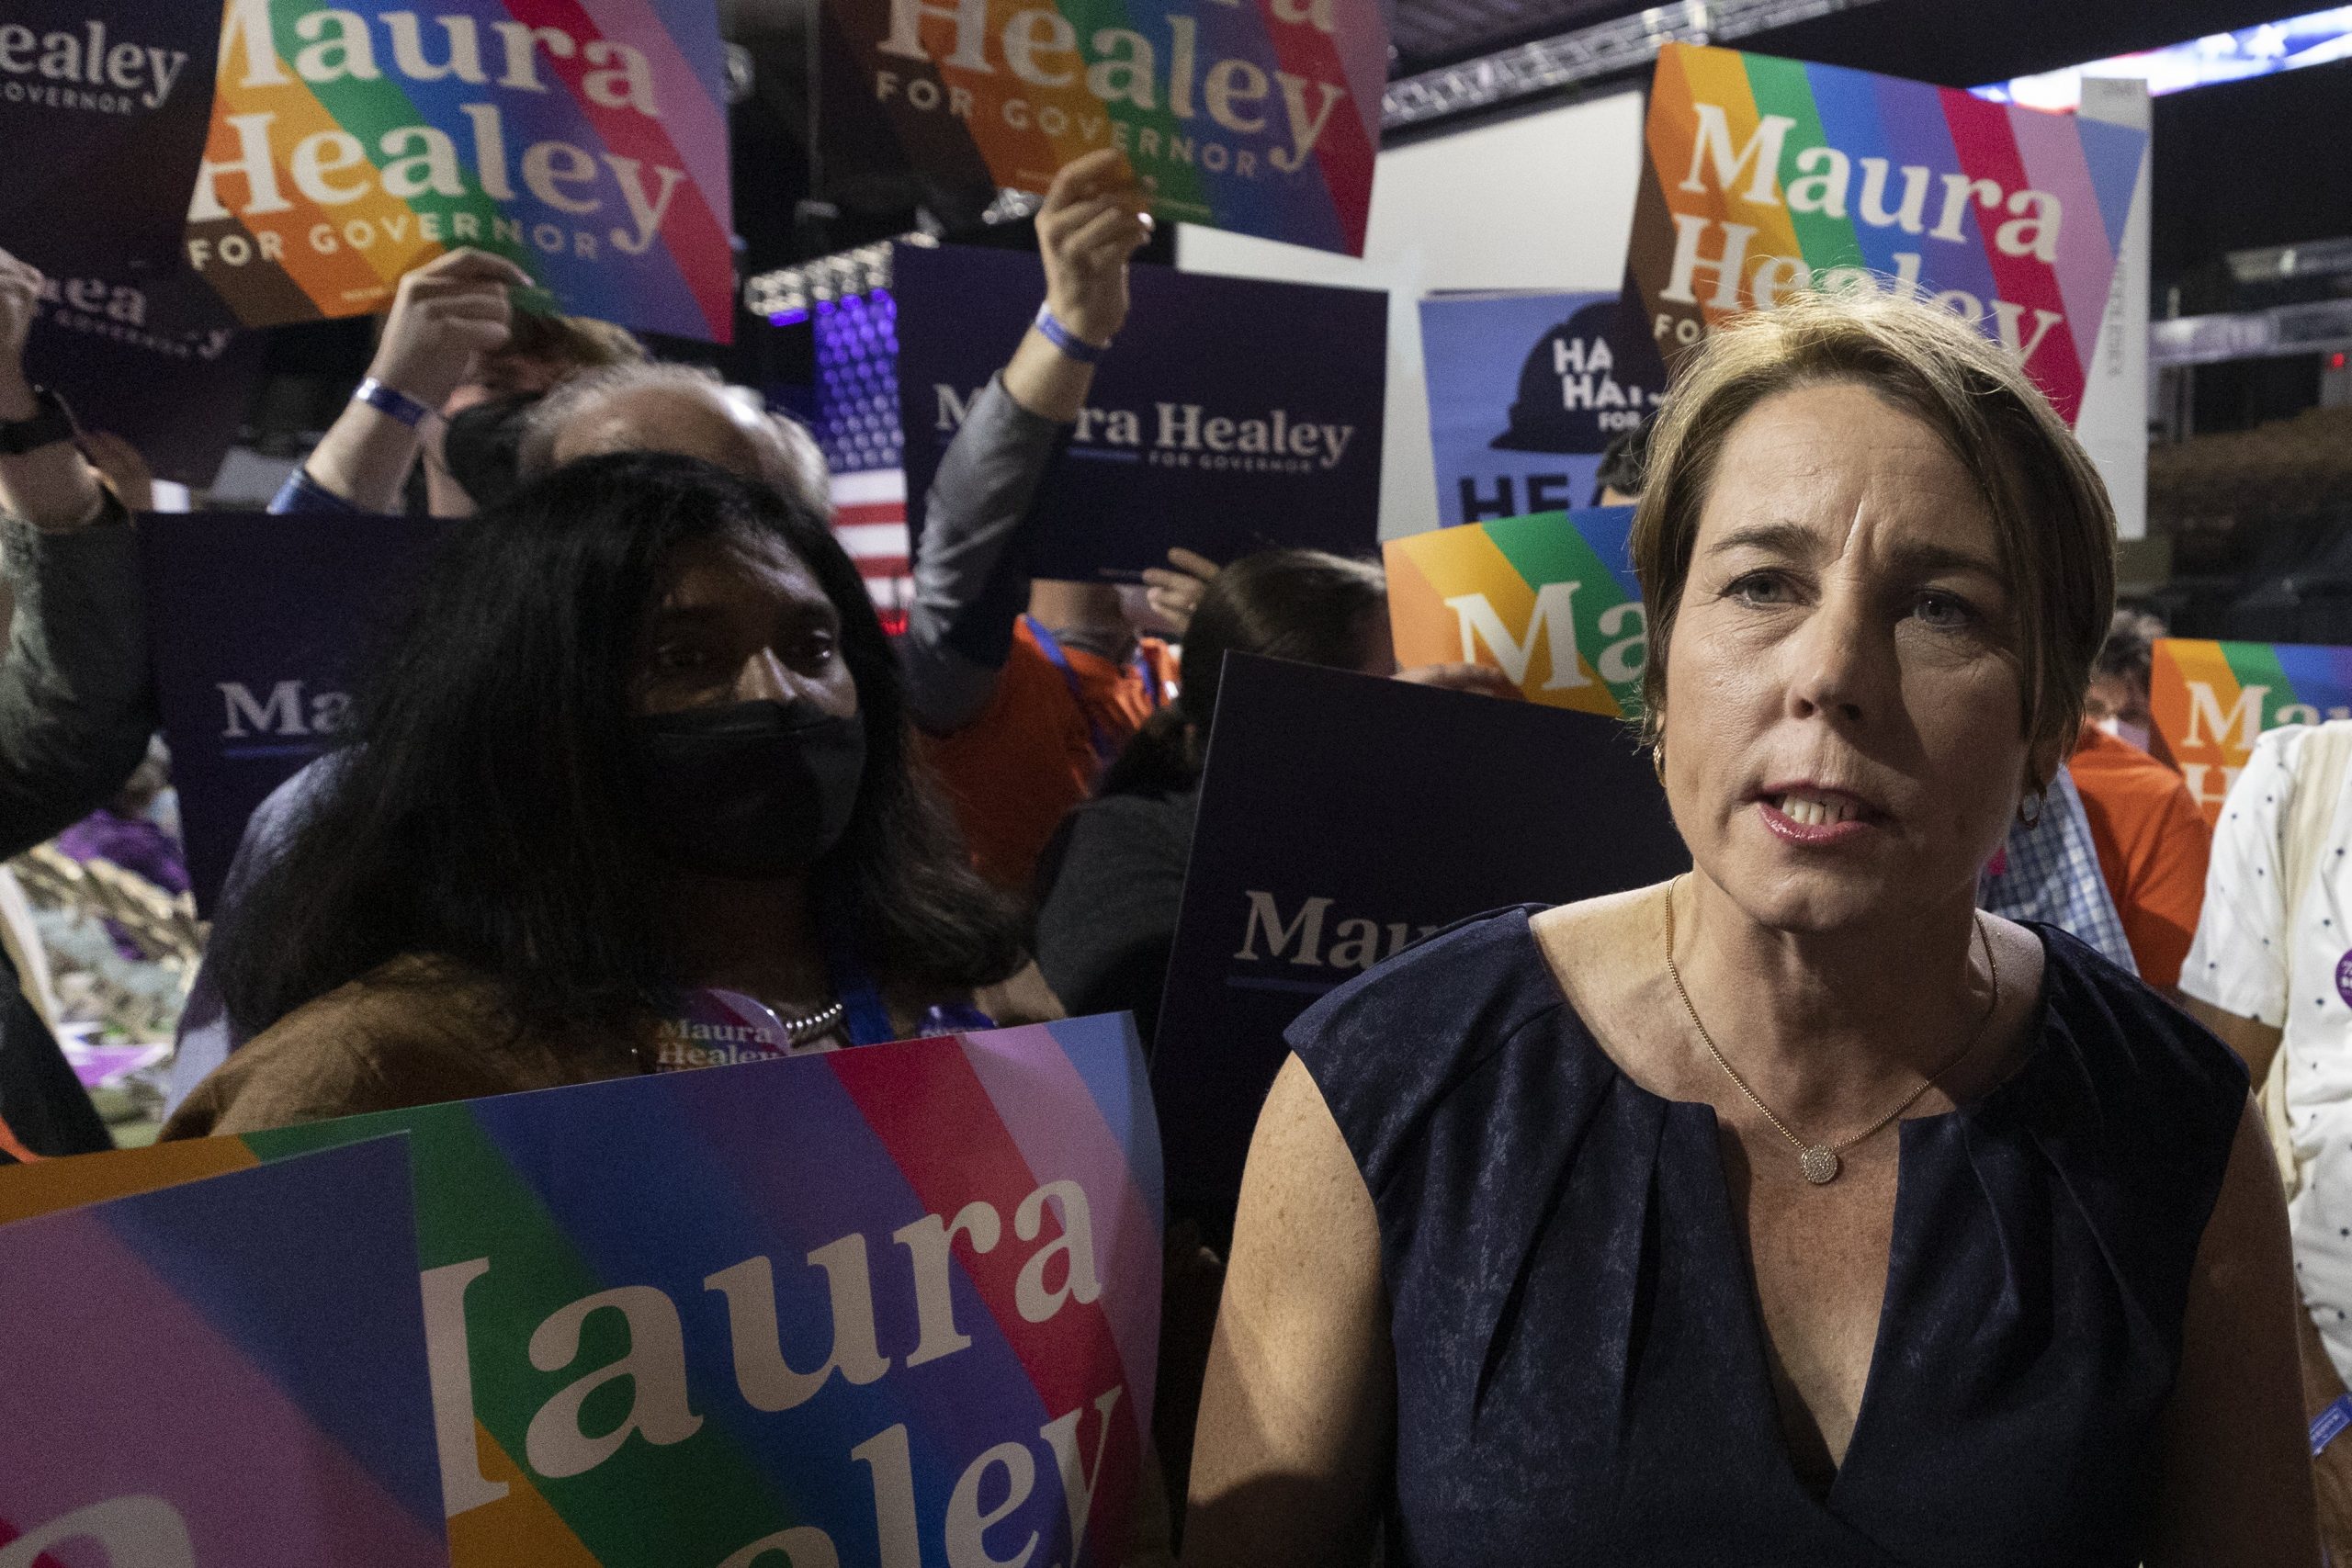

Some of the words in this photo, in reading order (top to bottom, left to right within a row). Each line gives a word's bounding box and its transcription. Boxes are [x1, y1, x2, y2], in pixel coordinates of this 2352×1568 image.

[876, 0, 1345, 172] Healey
[876, 71, 972, 117] FOR
[1002, 99, 1258, 178] GOVERNOR
[187, 103, 685, 255] Healey
[187, 230, 284, 271] FOR
[309, 212, 600, 260] GOVERNOR
[1678, 102, 2062, 264] Maura
[933, 383, 1141, 446] Mra
[1155, 401, 1355, 468] Healey
